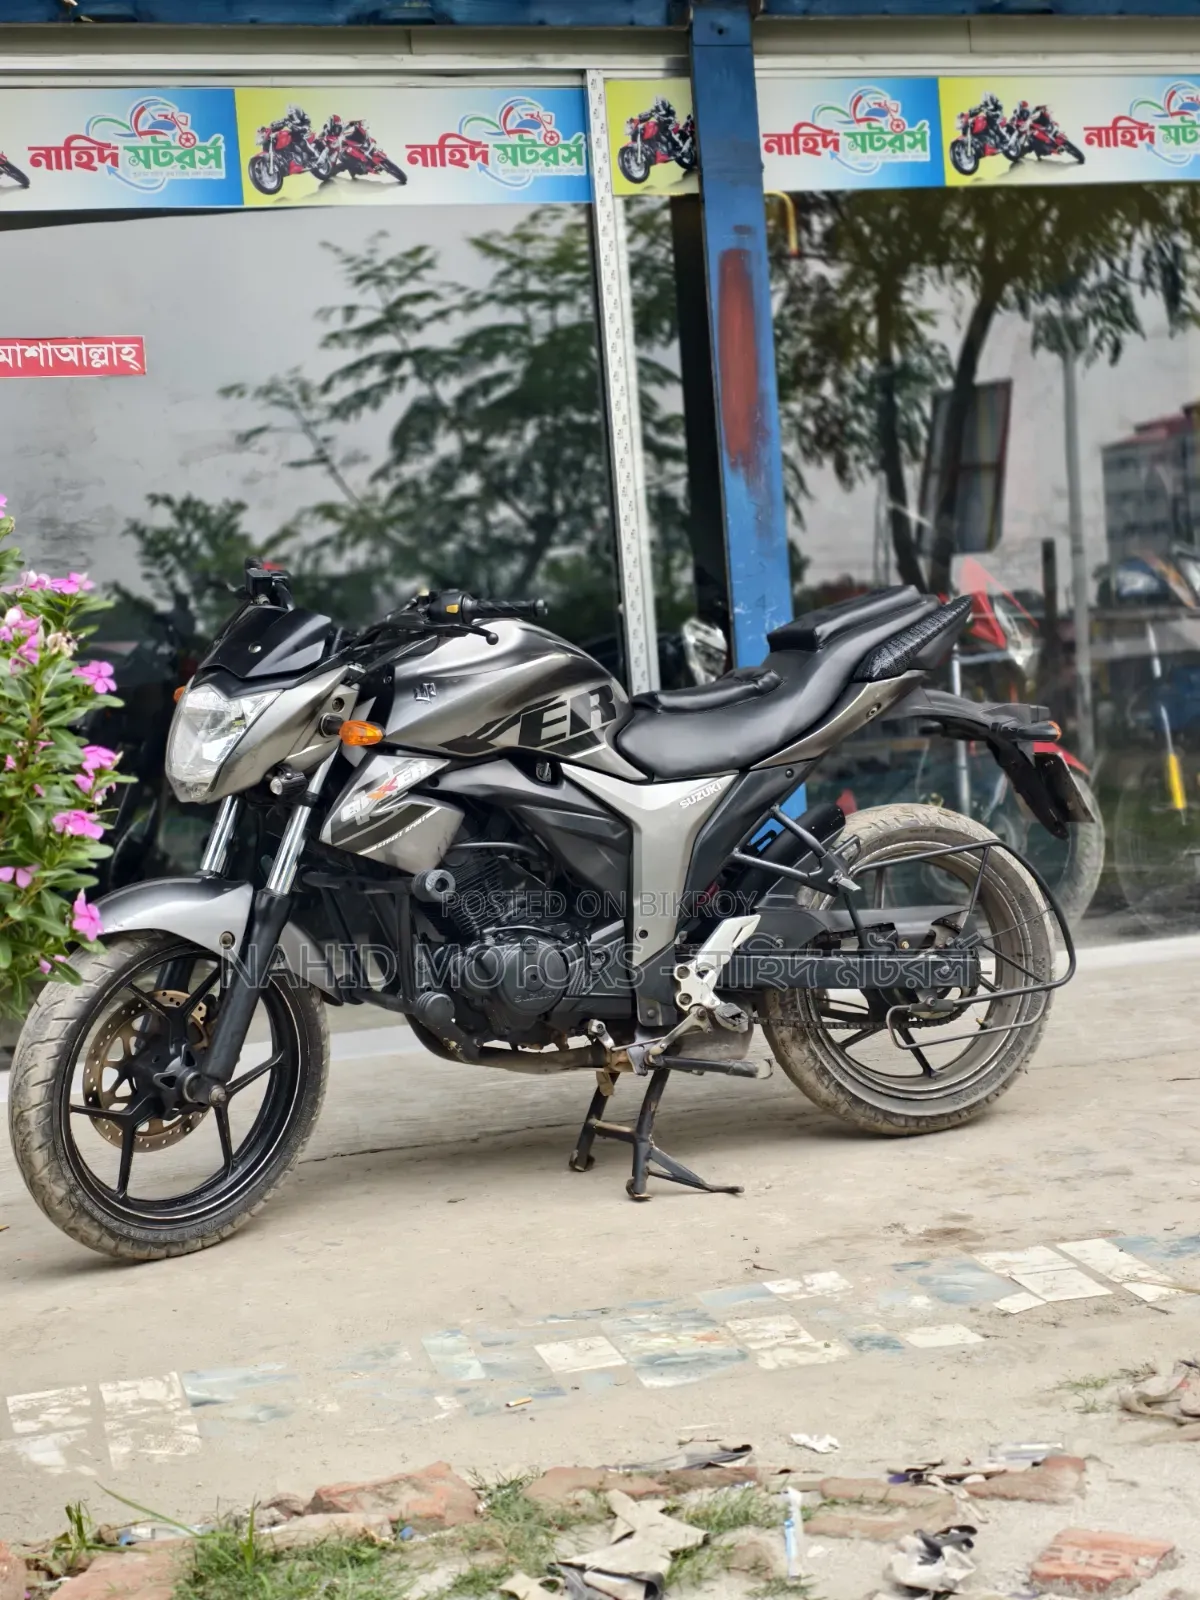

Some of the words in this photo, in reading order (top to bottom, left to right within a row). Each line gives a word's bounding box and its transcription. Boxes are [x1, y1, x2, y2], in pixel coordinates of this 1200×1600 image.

[762, 121, 840, 156] নাহিদ
[1083, 115, 1155, 148] নাহিদ
[27, 133, 119, 172] নাহিদ
[405, 132, 489, 168] নাহিদ
[679, 781, 722, 809] SUZUKI
